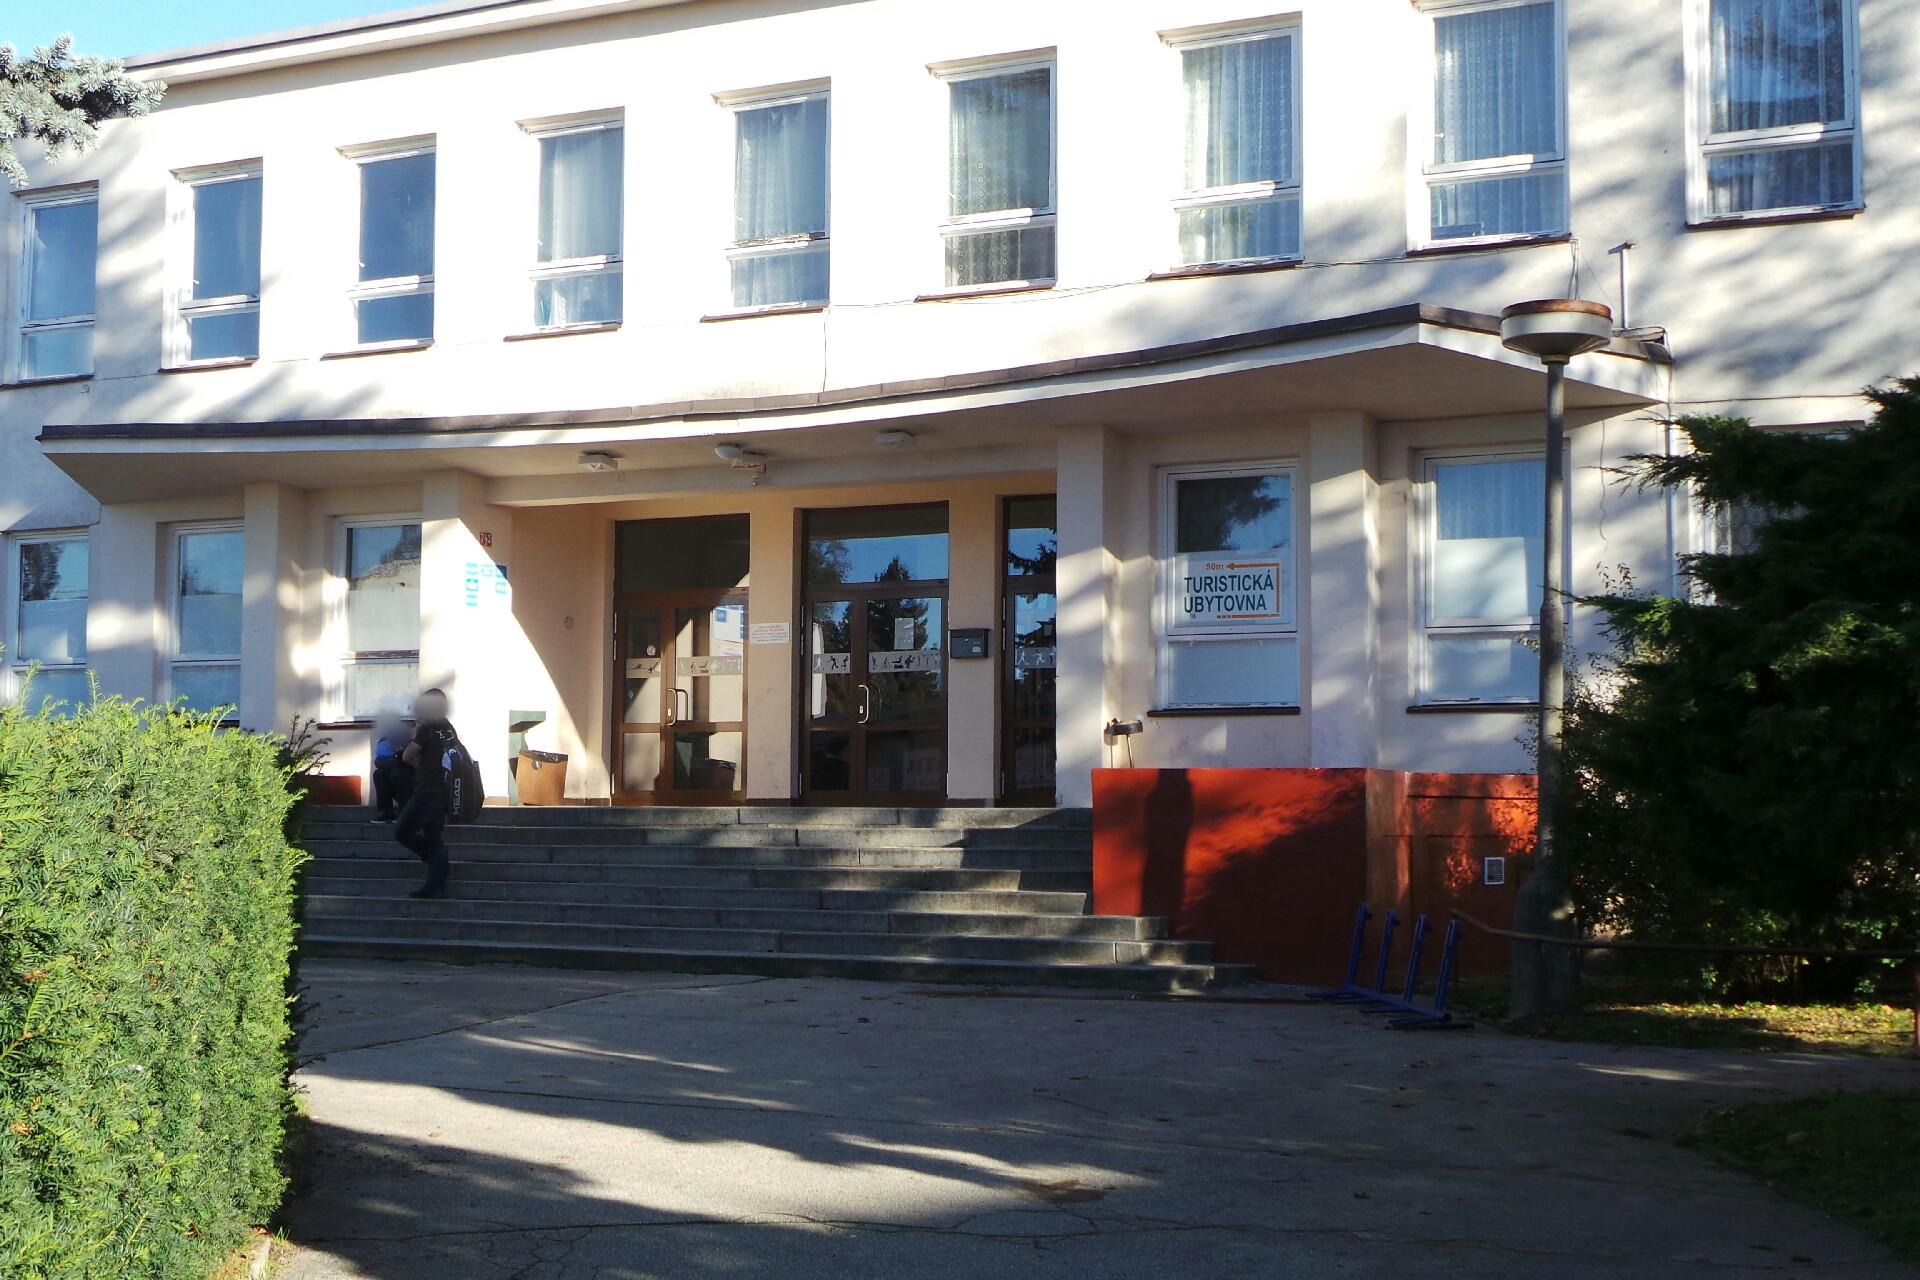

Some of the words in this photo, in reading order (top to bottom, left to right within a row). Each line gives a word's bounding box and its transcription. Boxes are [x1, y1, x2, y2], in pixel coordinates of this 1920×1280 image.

[1206, 563, 1224, 571] 50m
[1184, 569, 1274, 593] TURISTICKÁ
[1184, 594, 1267, 613] UBYTOVNA
[452, 778, 461, 815] HEAD
